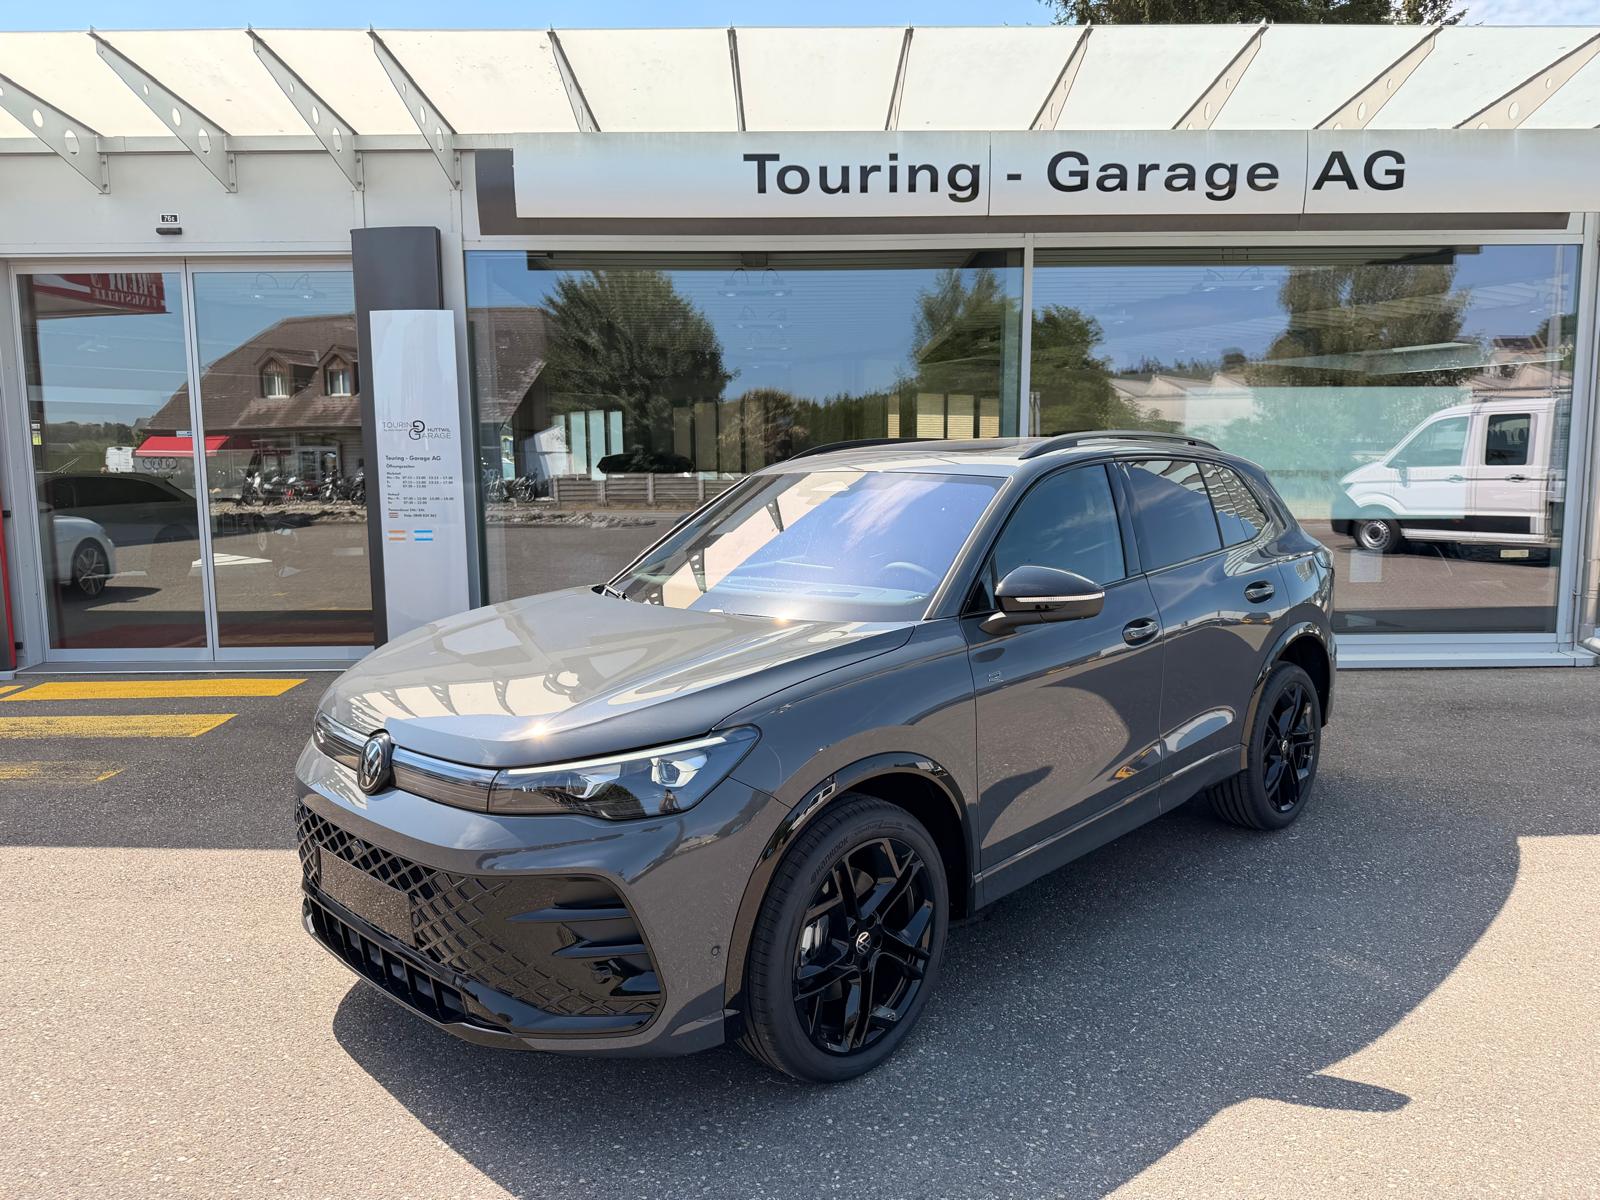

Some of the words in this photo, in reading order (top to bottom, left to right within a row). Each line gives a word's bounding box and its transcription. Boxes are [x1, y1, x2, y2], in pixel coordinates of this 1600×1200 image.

[743, 153, 981, 203] Touring
[1006, 173, 1022, 181] -
[1047, 151, 1279, 202] Garage
[1312, 150, 1405, 191] AG
